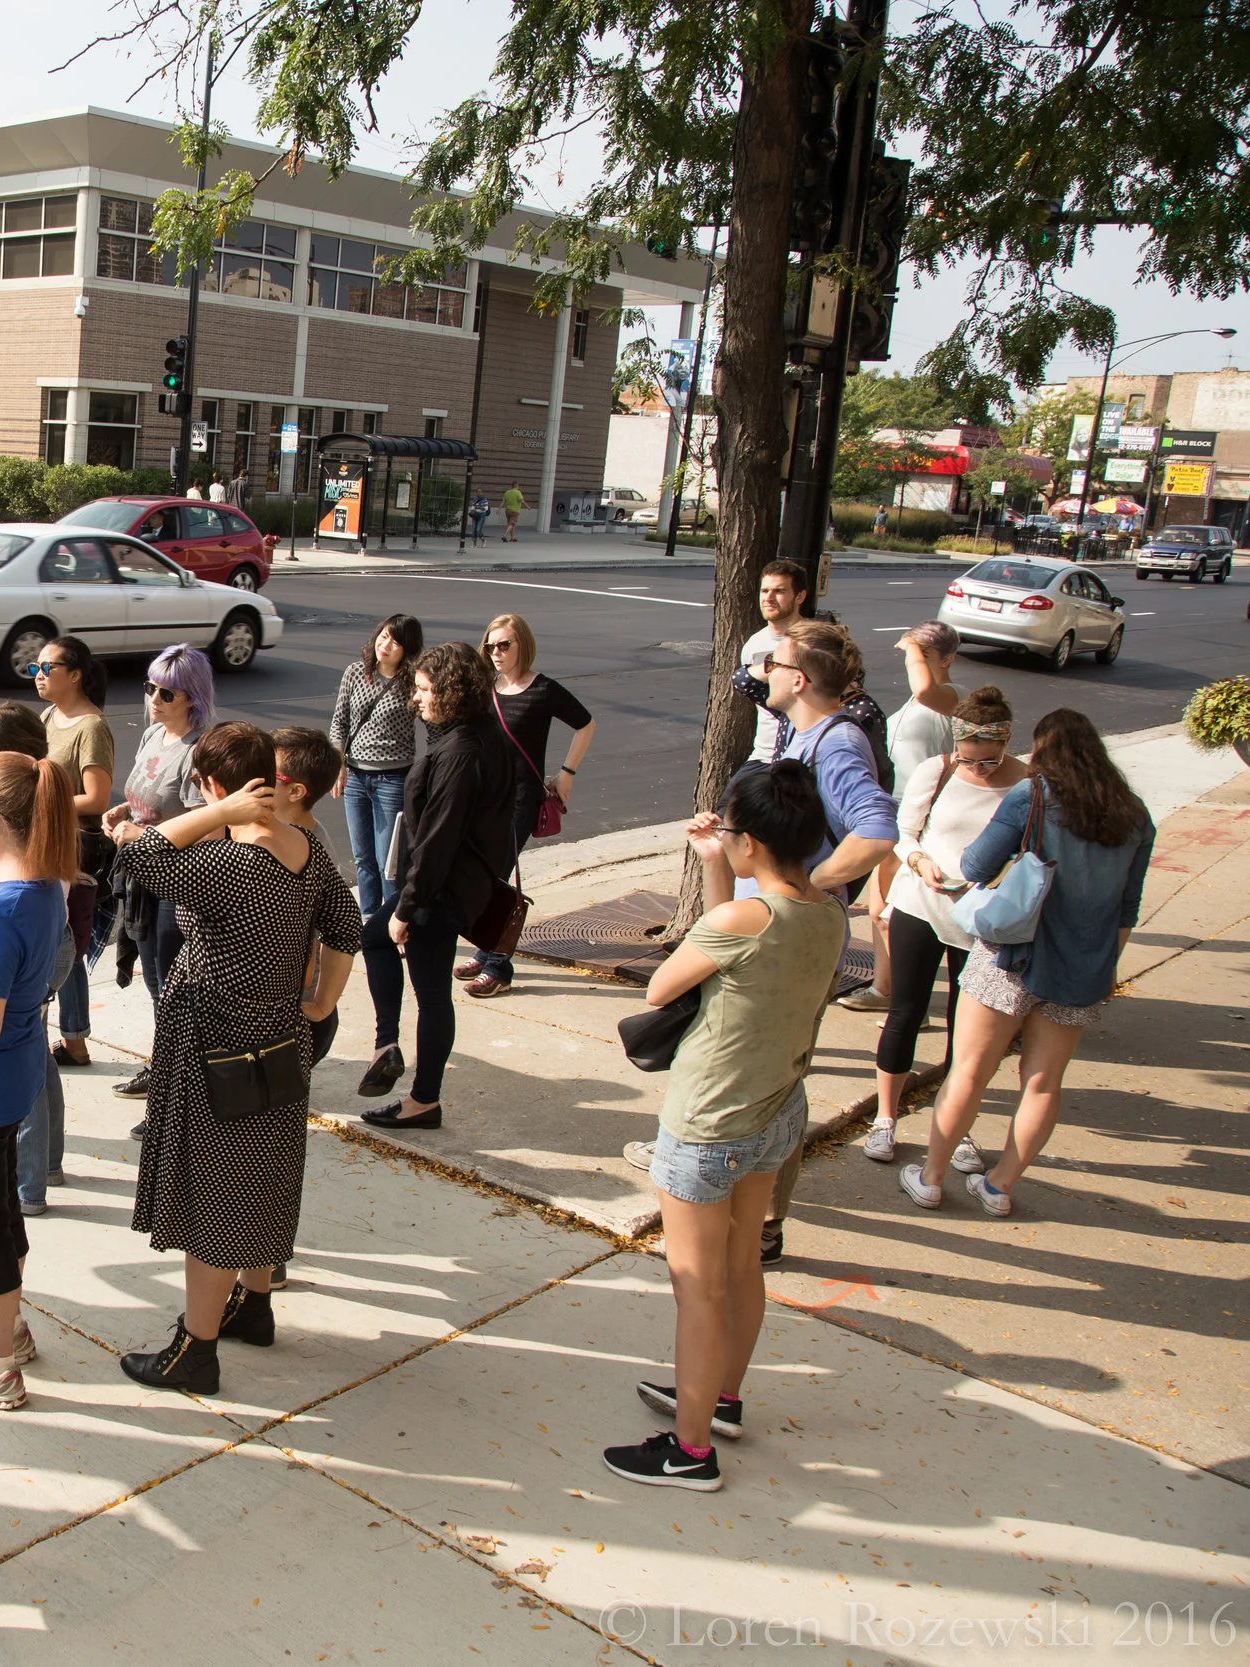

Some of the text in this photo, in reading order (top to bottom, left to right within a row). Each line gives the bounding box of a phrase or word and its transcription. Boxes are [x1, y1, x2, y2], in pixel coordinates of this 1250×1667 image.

[1103, 411, 1121, 419] LIVE
[192, 423, 206, 432] ONE
[1101, 425, 1116, 433] THE
[512, 428, 538, 439] CHICAGO
[325, 478, 361, 489] UNLIMITED
